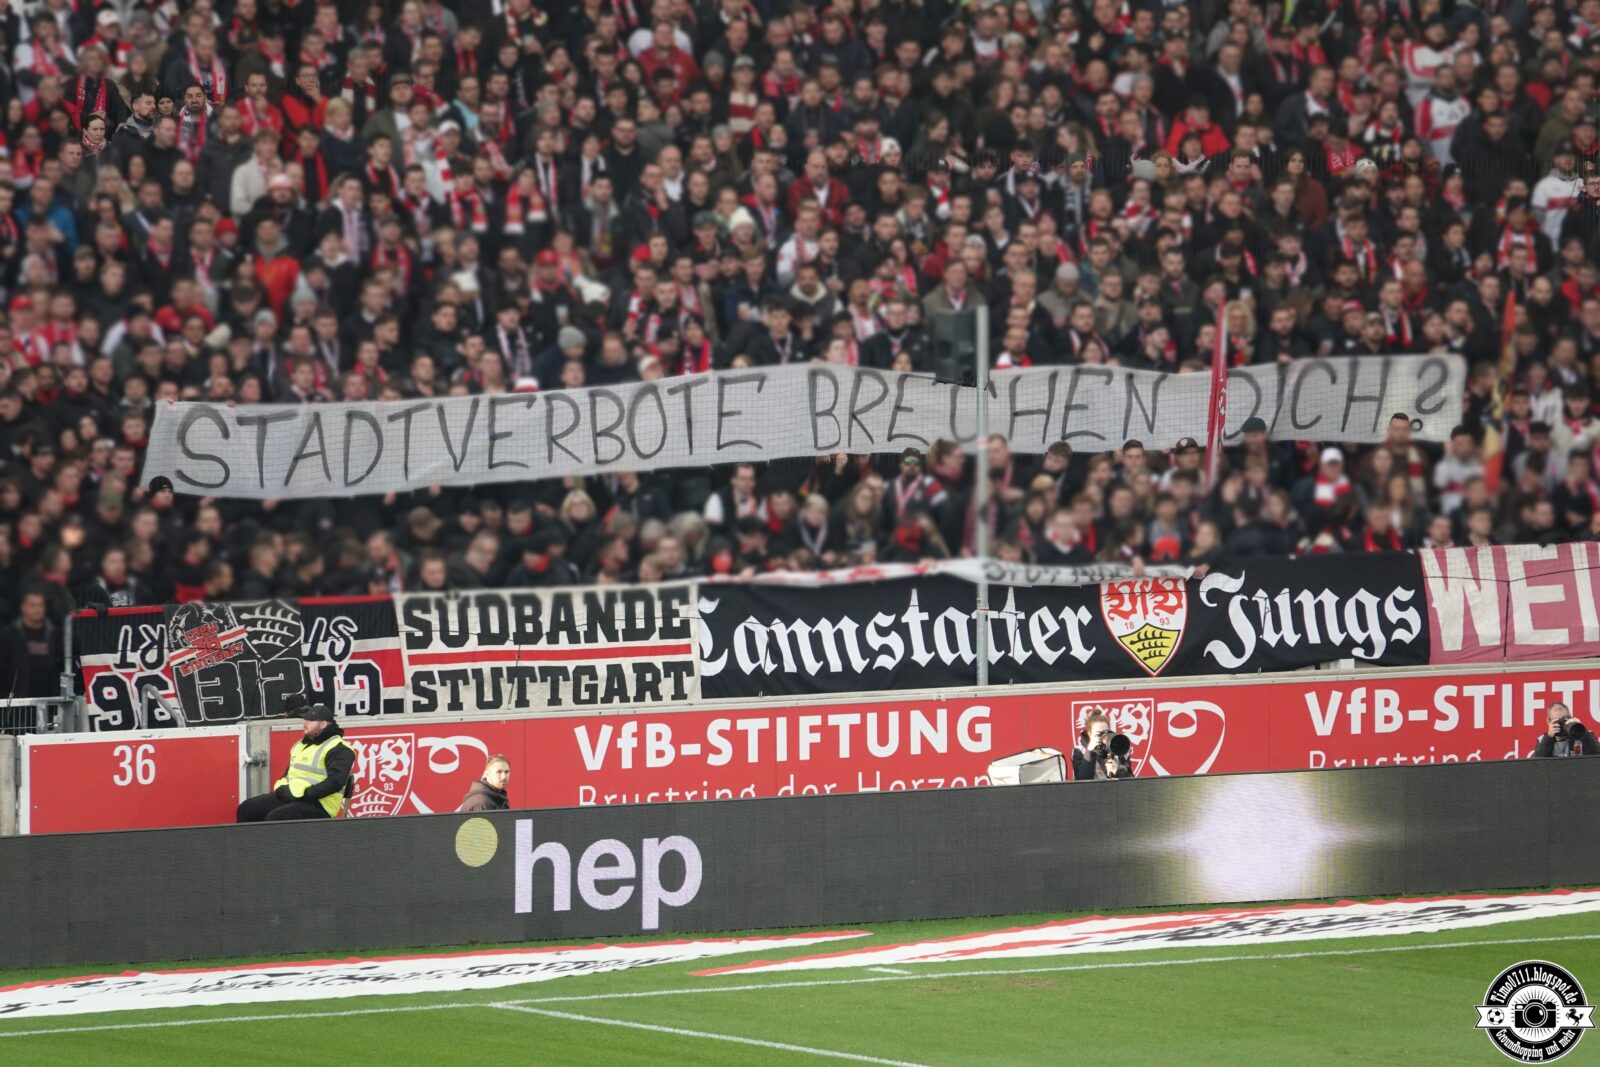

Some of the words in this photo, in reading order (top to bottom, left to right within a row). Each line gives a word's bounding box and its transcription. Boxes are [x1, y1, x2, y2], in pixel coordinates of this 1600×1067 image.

[174, 373, 768, 490] STADTVERBOTE
[402, 585, 692, 650] SÜDBANDE
[1125, 620, 1136, 630] 18
[1159, 616, 1171, 627] 93
[1200, 570, 1423, 669] Jungs
[173, 658, 306, 723] 1312
[410, 660, 695, 713] STUTTGART
[112, 743, 157, 787] 36
[574, 706, 992, 771] VfB-STIFTUNG
[383, 782, 395, 792] 93
[514, 818, 703, 930] hep
